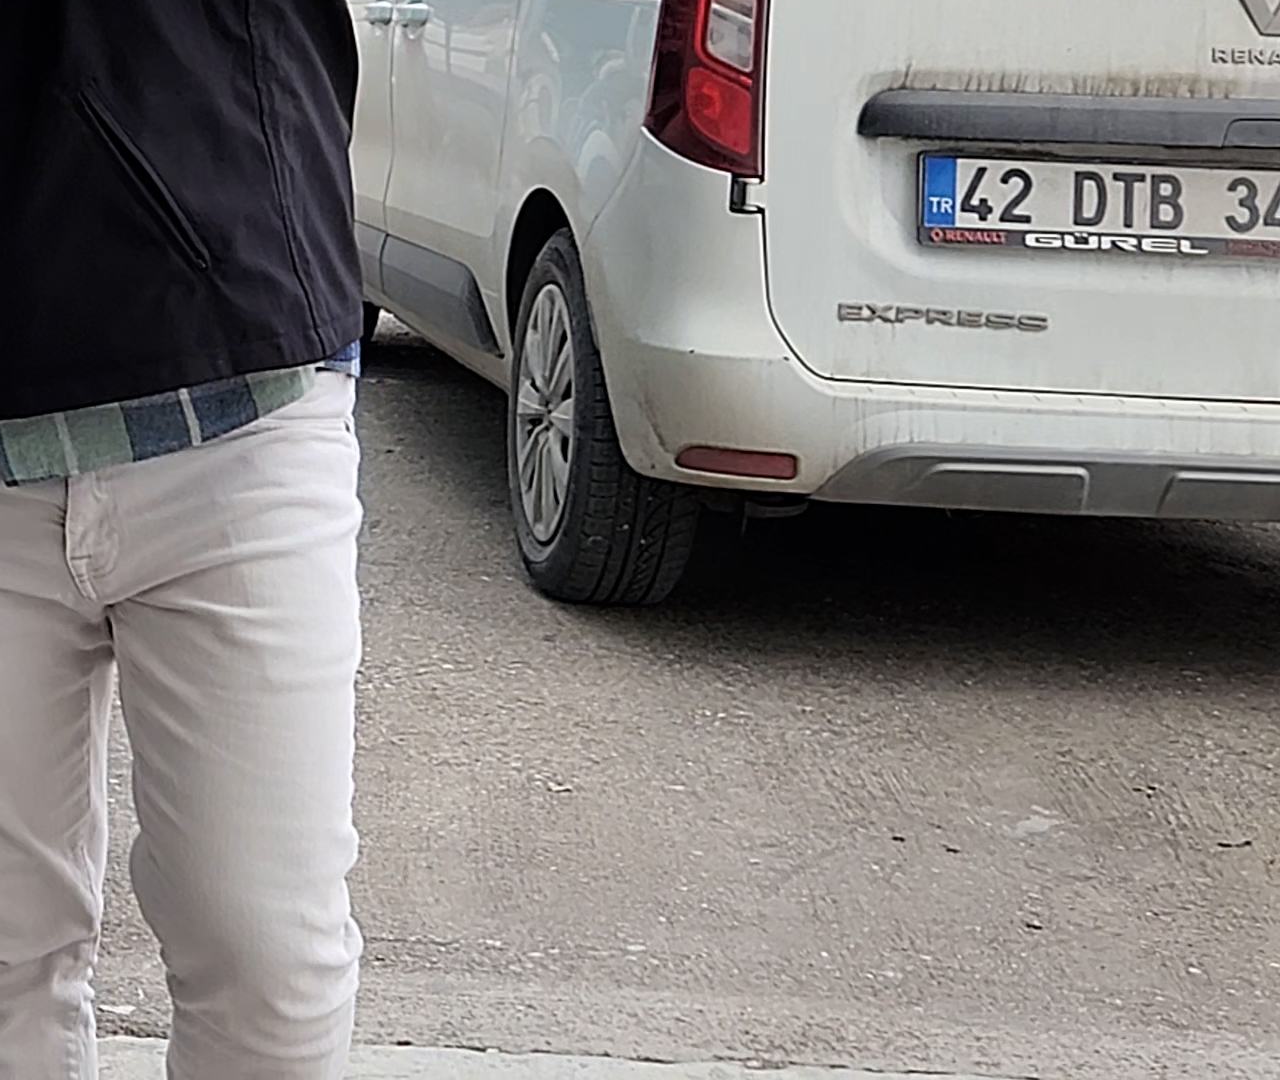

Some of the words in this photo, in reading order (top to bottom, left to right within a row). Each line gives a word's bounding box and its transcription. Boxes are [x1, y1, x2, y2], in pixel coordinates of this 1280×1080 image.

[929, 197, 954, 215] TR
[960, 166, 1034, 224] 42
[1073, 171, 1184, 230] DTB
[944, 229, 1007, 244] RENAULT
[1024, 232, 1209, 255] GÜREL
[837, 302, 1049, 332] EXPRESS
